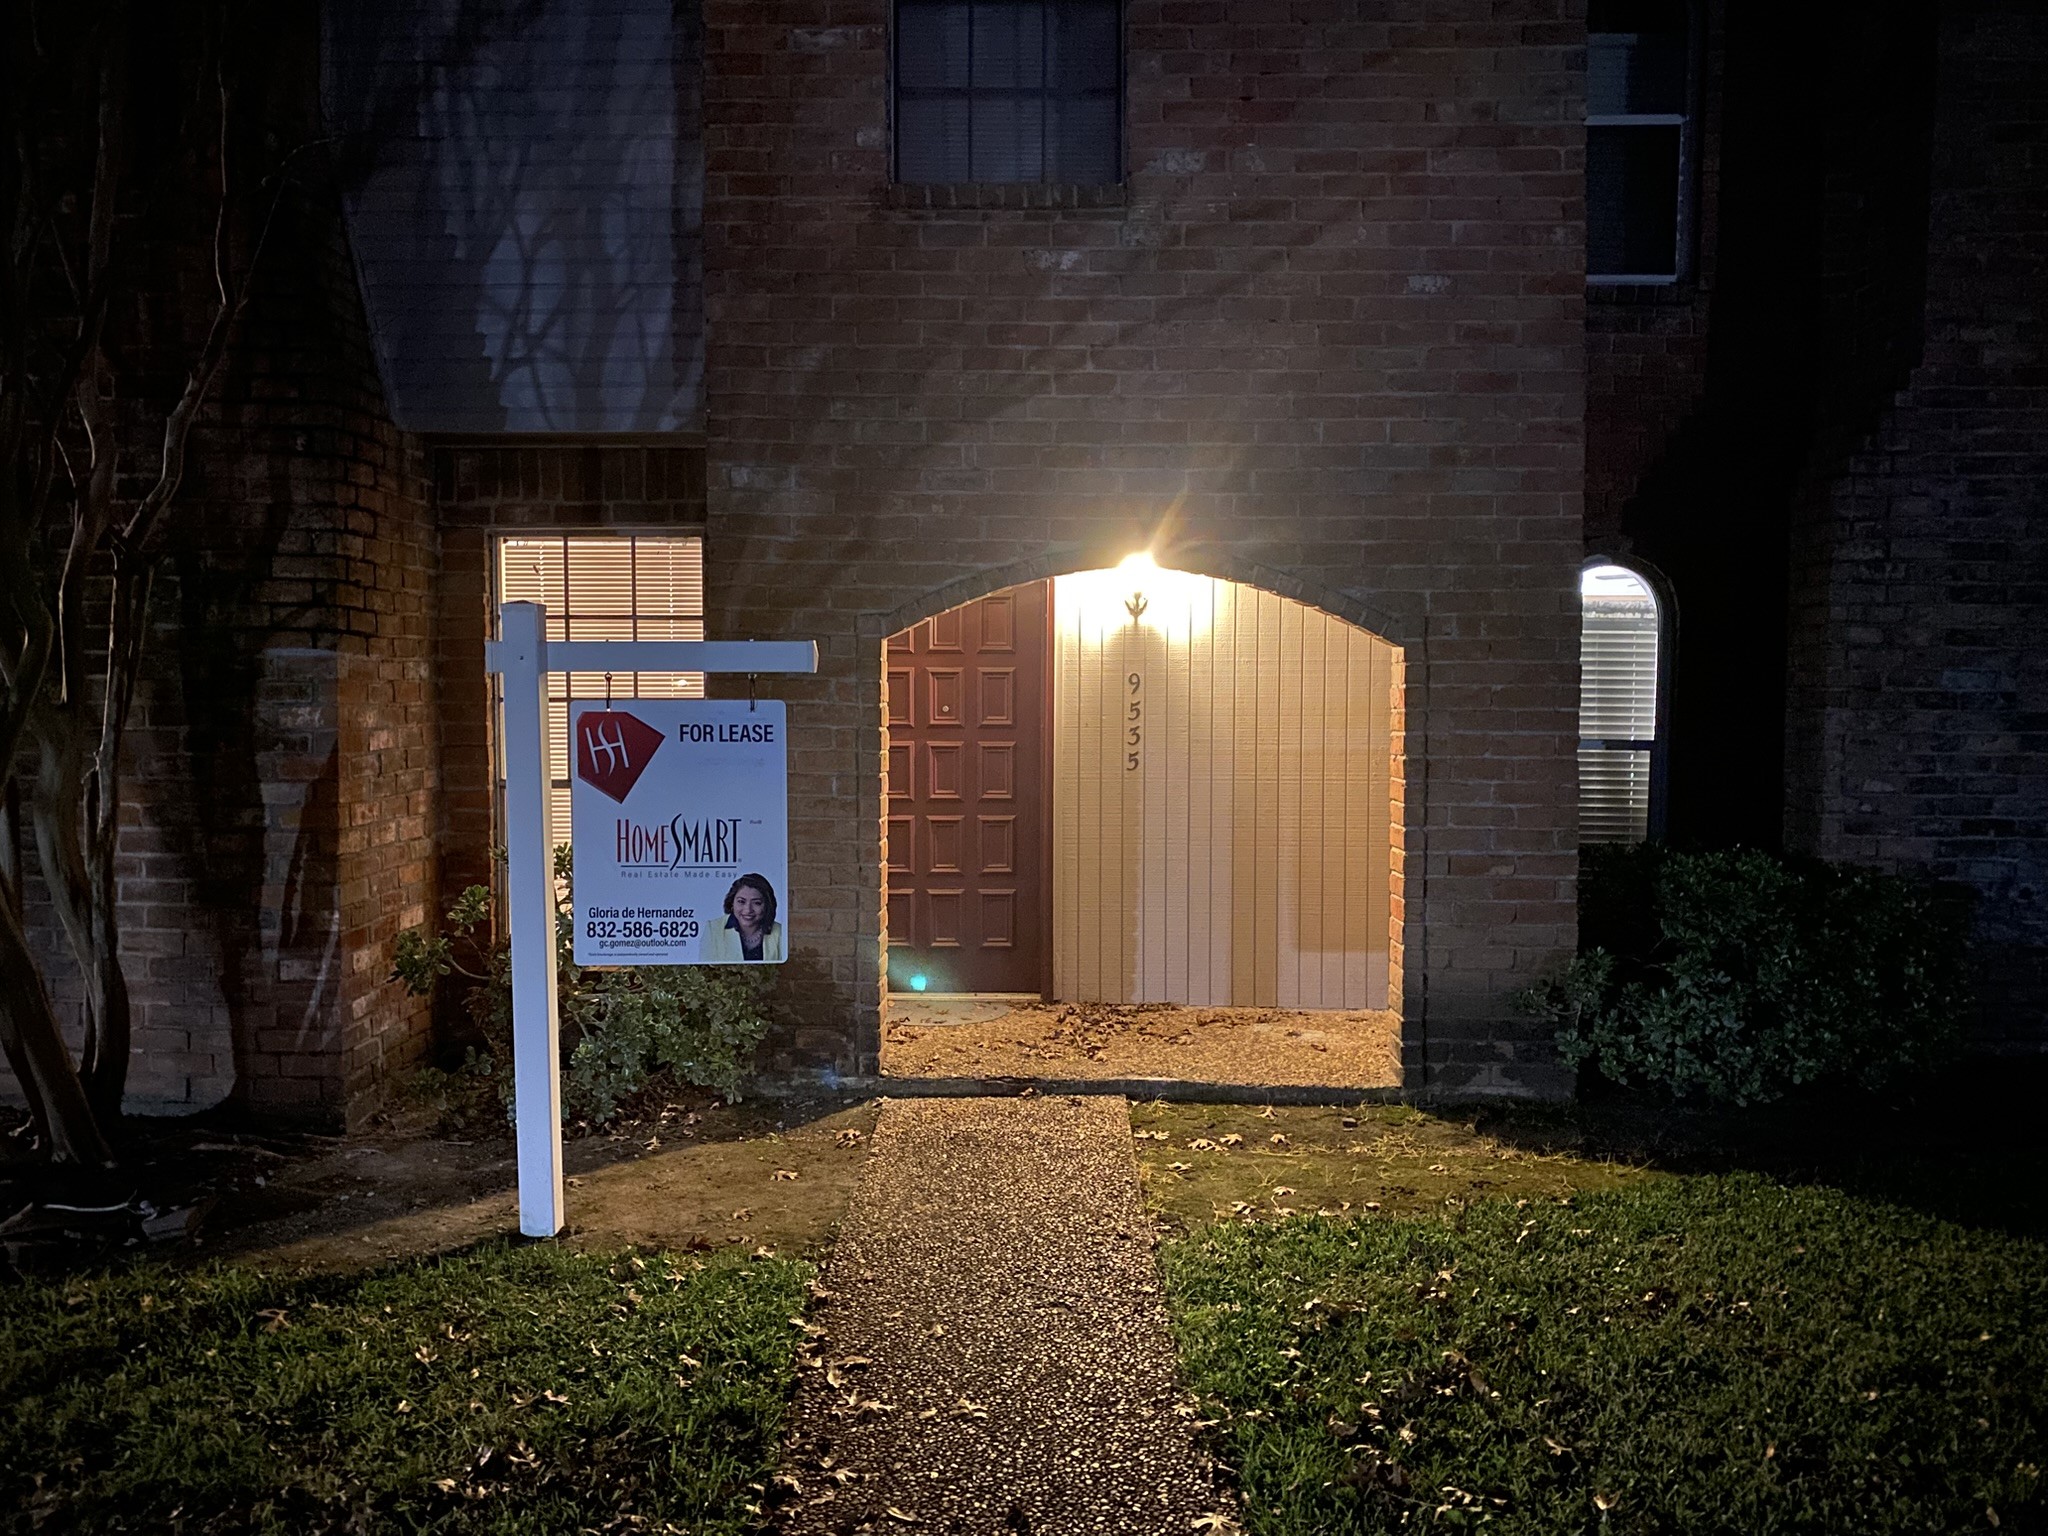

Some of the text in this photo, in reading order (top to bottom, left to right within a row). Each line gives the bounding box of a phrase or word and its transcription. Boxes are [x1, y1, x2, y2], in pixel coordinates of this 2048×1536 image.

[1126, 672, 1141, 771] 9535
[679, 724, 774, 743] FOR LEASE
[621, 870, 738, 880] Real Estate Made Easy
[588, 907, 694, 919] Gloria de Hernandez
[586, 921, 699, 938] 832-586-6829
[599, 938, 687, 949] gc.gomez@outlook.com
